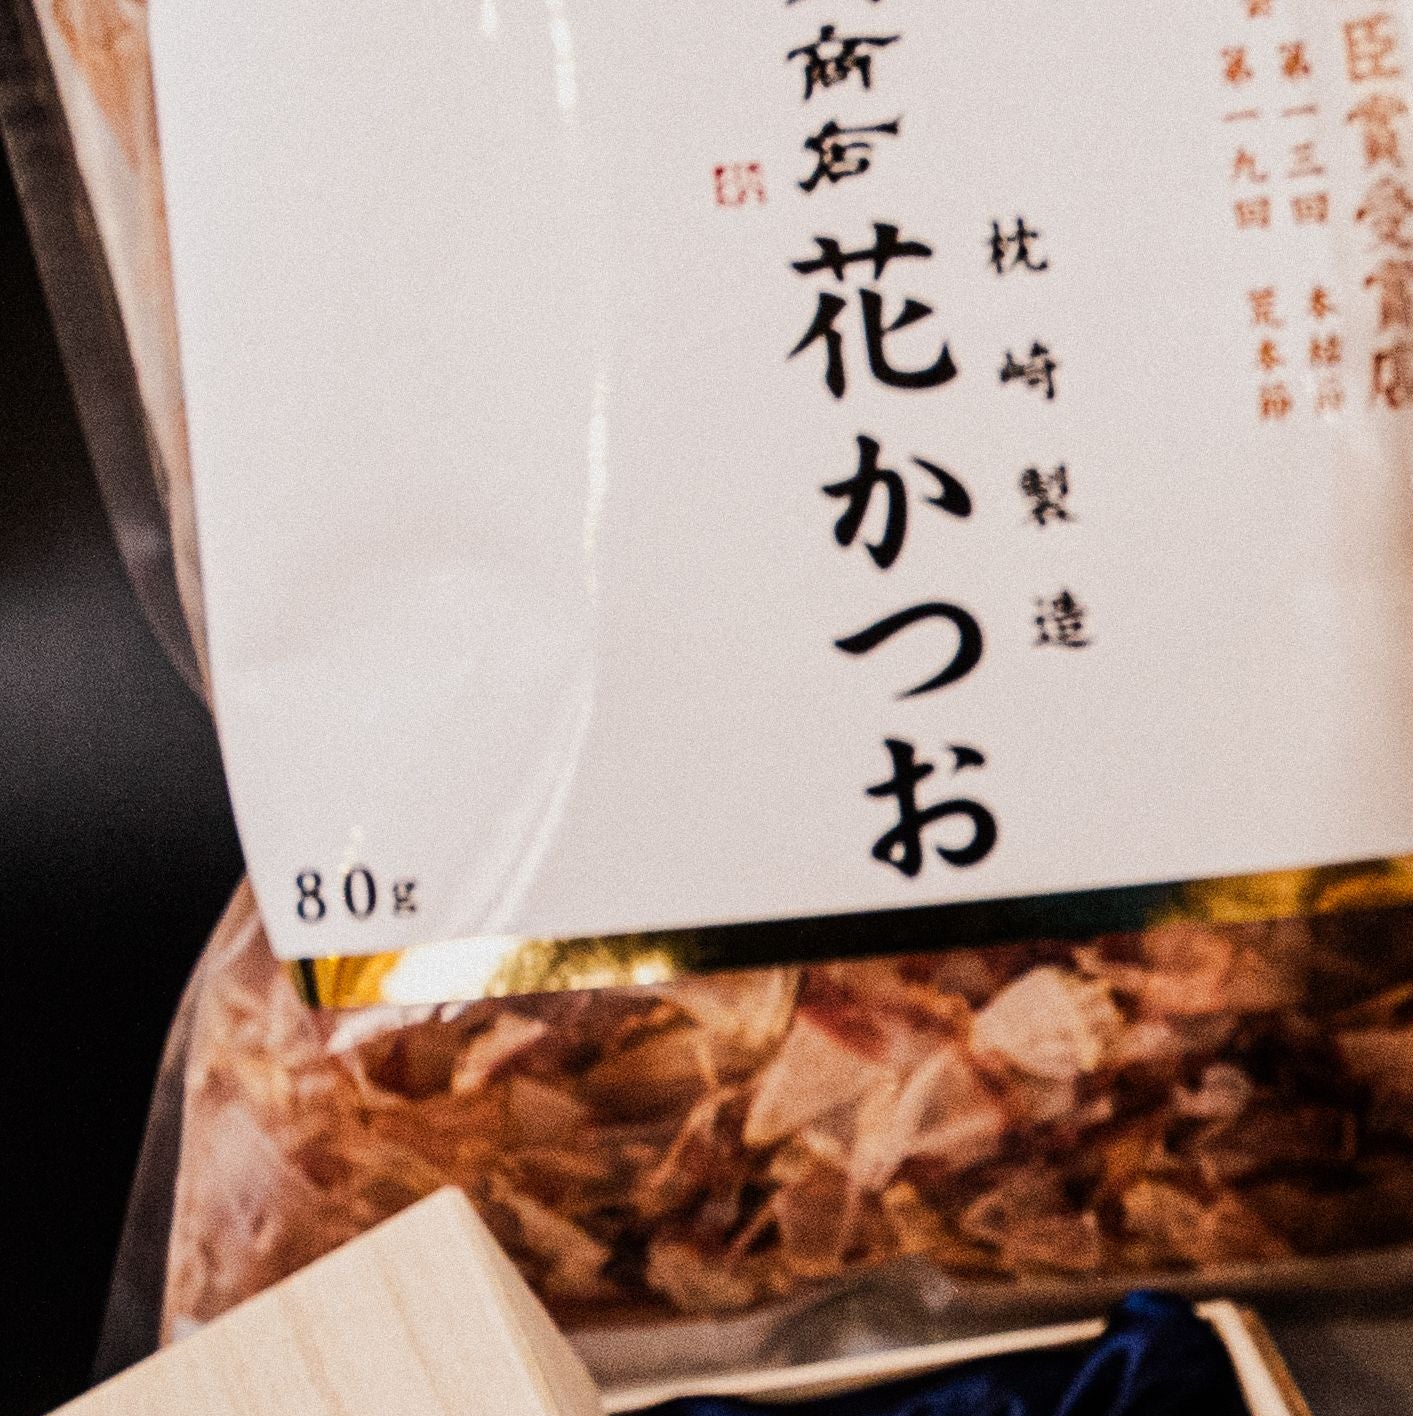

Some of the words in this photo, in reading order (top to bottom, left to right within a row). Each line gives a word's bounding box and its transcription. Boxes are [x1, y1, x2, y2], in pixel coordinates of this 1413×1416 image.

[785, 0, 902, 192] 商店
[789, 222, 998, 878] 花かつお
[987, 216, 1092, 650] 枕崎製造
[296, 865, 419, 923] 80g
